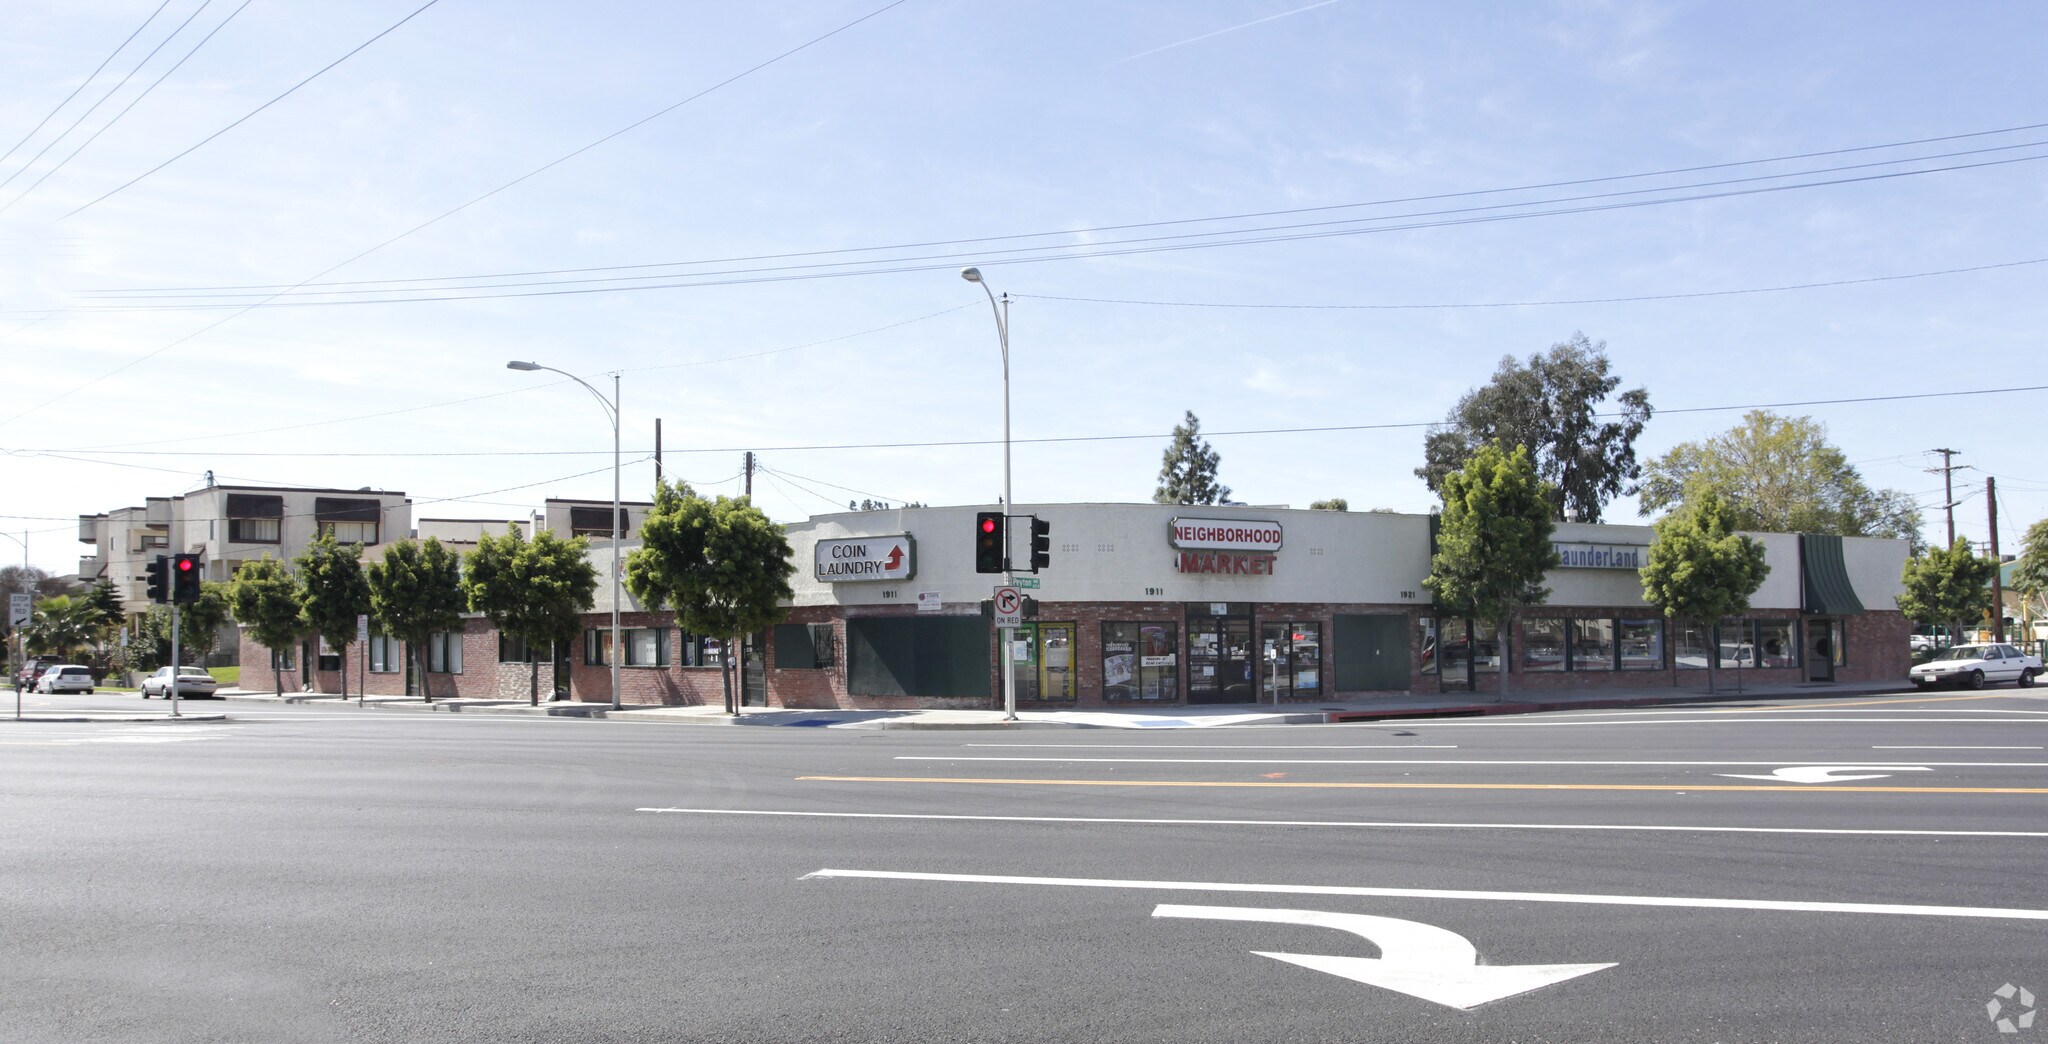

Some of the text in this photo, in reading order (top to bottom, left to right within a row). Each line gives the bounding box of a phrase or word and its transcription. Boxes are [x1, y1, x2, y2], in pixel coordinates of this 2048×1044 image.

[1174, 526, 1281, 544] NEIGHBORHOOD
[832, 544, 866, 559] COIN
[818, 561, 883, 576] LAUNDRY
[1179, 552, 1278, 576] MARKET
[882, 591, 898, 599] 1911
[1145, 587, 1163, 596] 1911
[1400, 590, 1416, 599] 1921
[996, 616, 1019, 624] ON RED
